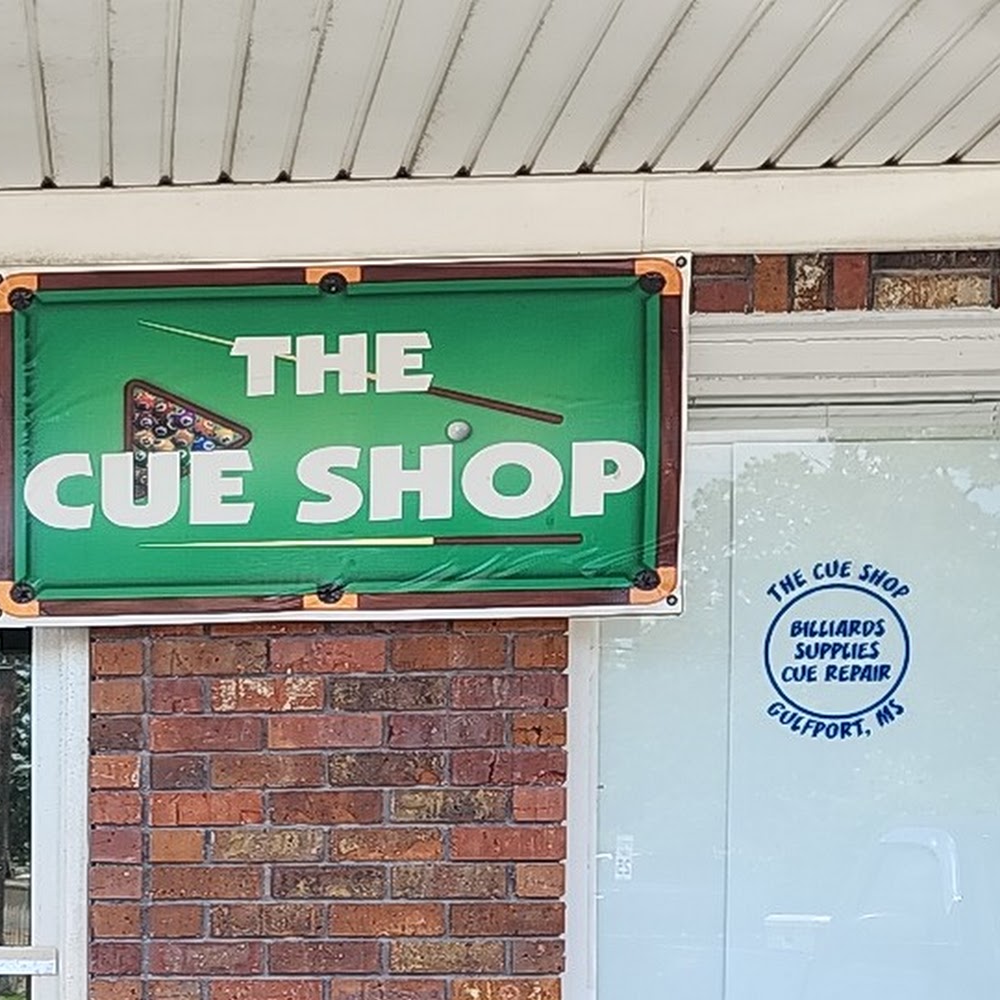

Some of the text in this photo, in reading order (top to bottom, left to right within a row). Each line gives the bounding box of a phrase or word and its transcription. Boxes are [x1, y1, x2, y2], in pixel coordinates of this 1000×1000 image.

[229, 331, 434, 396] THE
[22, 440, 646, 530] CUE SHOP
[767, 559, 910, 602] THE CUE SHOP
[790, 618, 886, 637] BILLIARDS
[794, 641, 880, 660] SUPPLIES
[781, 665, 892, 682] CUE REPAIR
[767, 699, 905, 739] GULFPORT, MS
